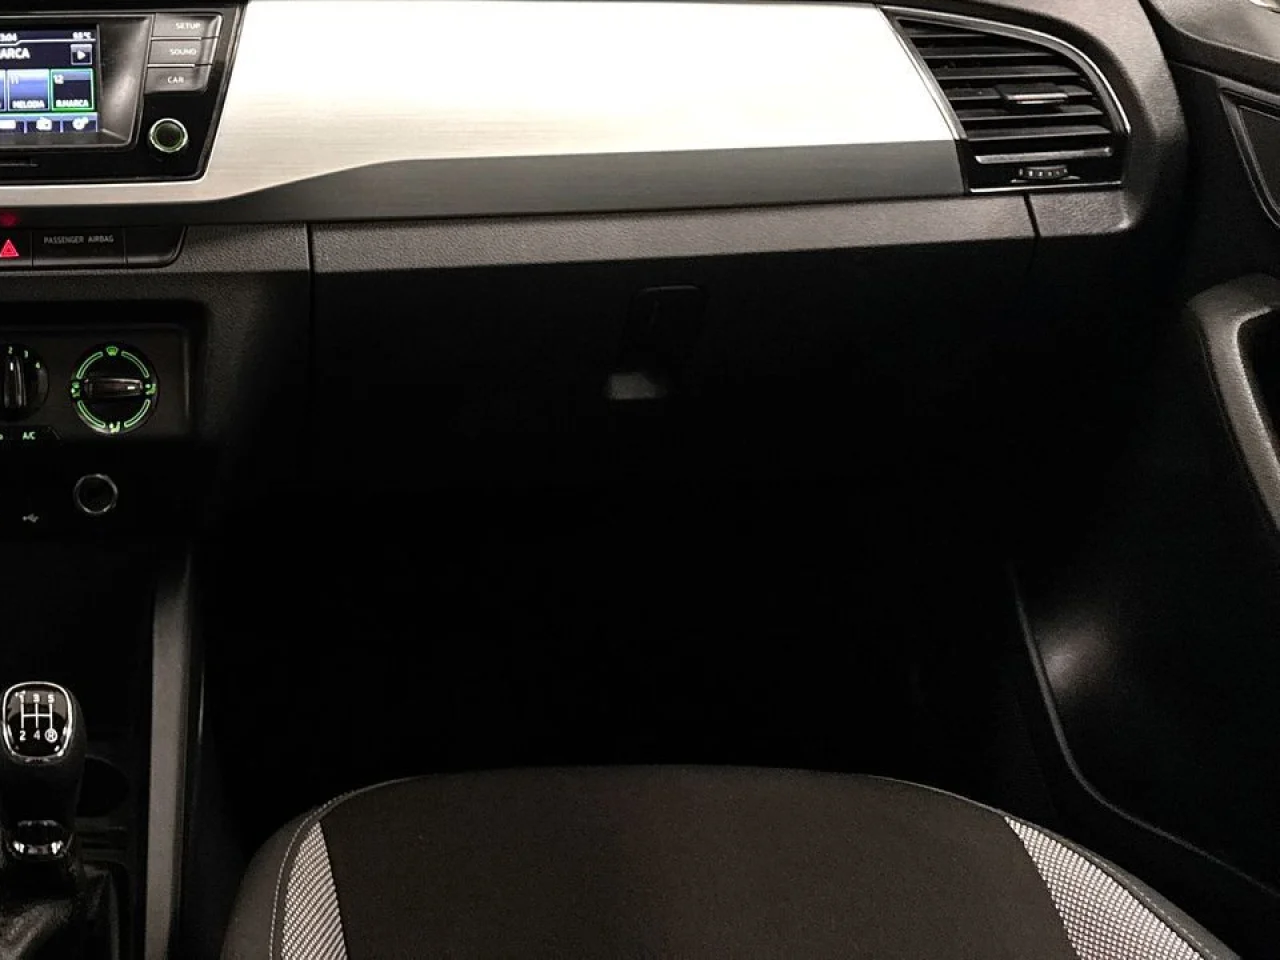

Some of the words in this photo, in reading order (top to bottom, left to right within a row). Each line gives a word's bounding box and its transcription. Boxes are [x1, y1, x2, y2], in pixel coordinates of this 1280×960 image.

[175, 22, 201, 30] SETUP
[169, 48, 197, 56] SOUND
[167, 76, 185, 84] CAR
[43, 236, 84, 245] PASSENGER
[87, 235, 114, 243] AIRBAG
[7, 346, 13, 354] 2
[22, 431, 36, 440] A/C
[32, 693, 40, 702] 3
[47, 693, 55, 703] 5
[19, 730, 27, 741] 2
[33, 730, 40, 740] 4
